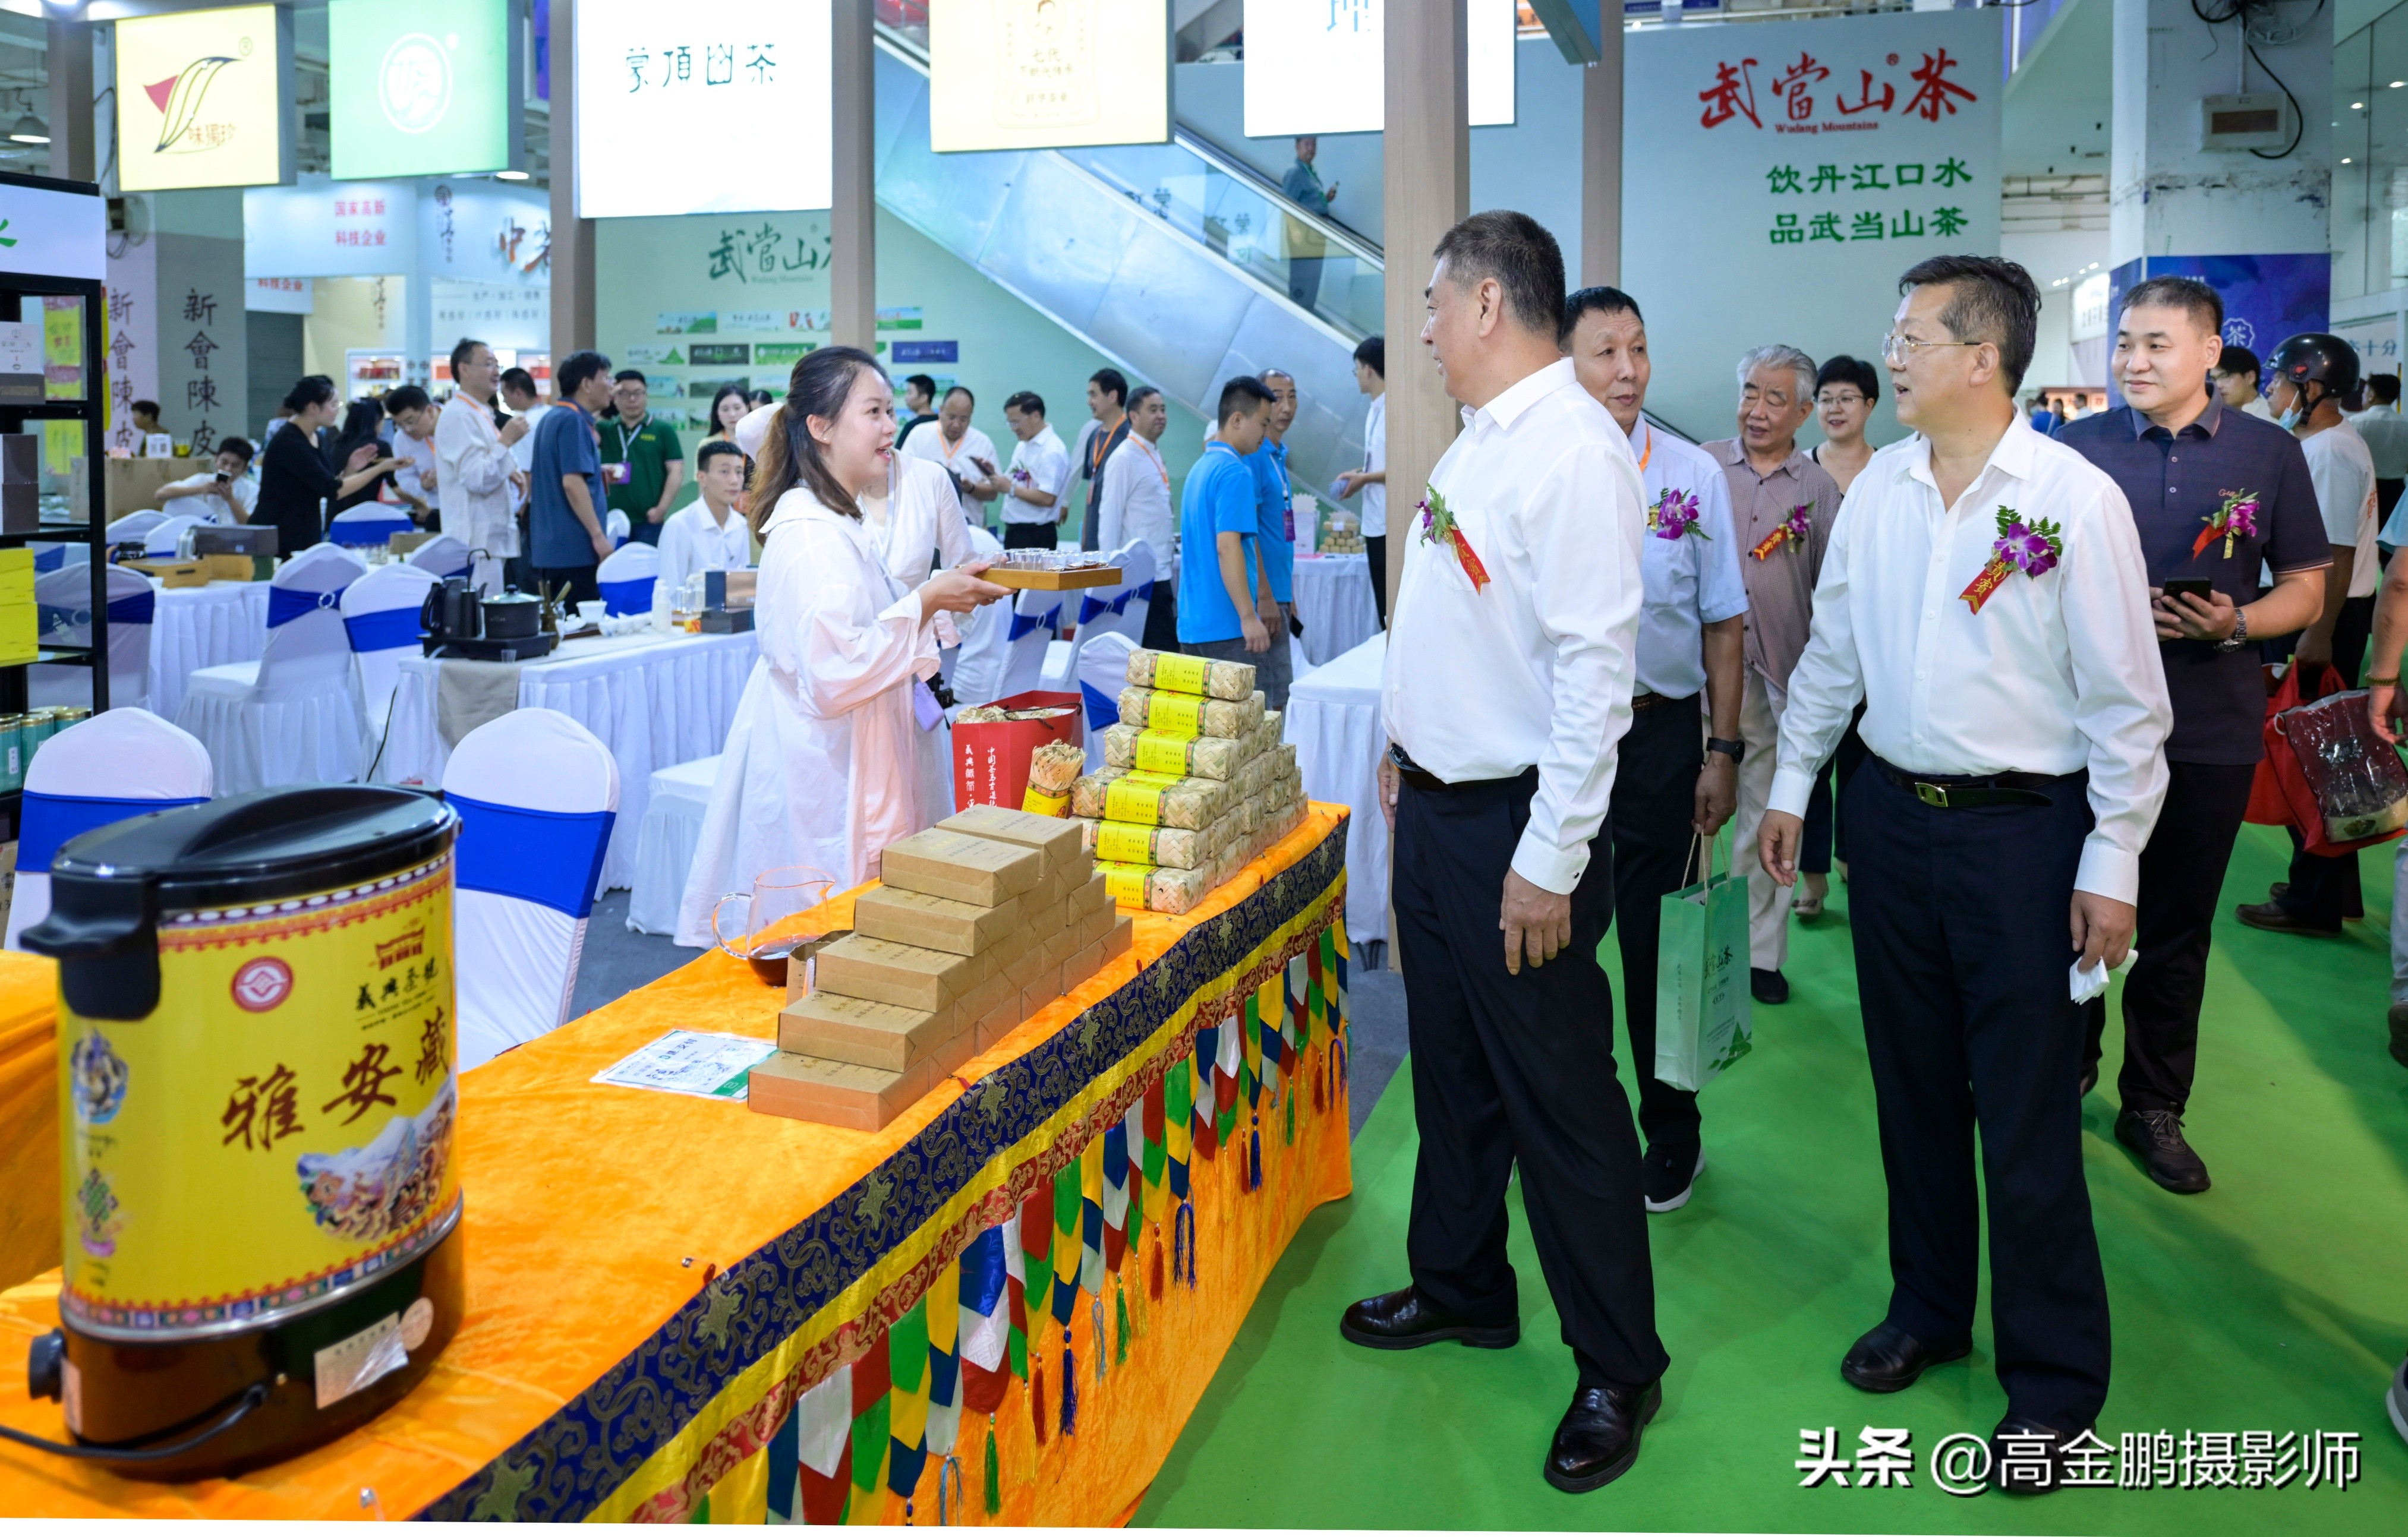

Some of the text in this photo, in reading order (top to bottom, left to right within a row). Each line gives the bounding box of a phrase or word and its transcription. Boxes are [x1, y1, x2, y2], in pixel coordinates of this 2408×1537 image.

[1775, 120, 1879, 134] Wudang Mountains
[1766, 156, 1973, 194] 饮丹江口水
[1769, 206, 1969, 244] 品武当山茶
[708, 221, 831, 285] 武當山
